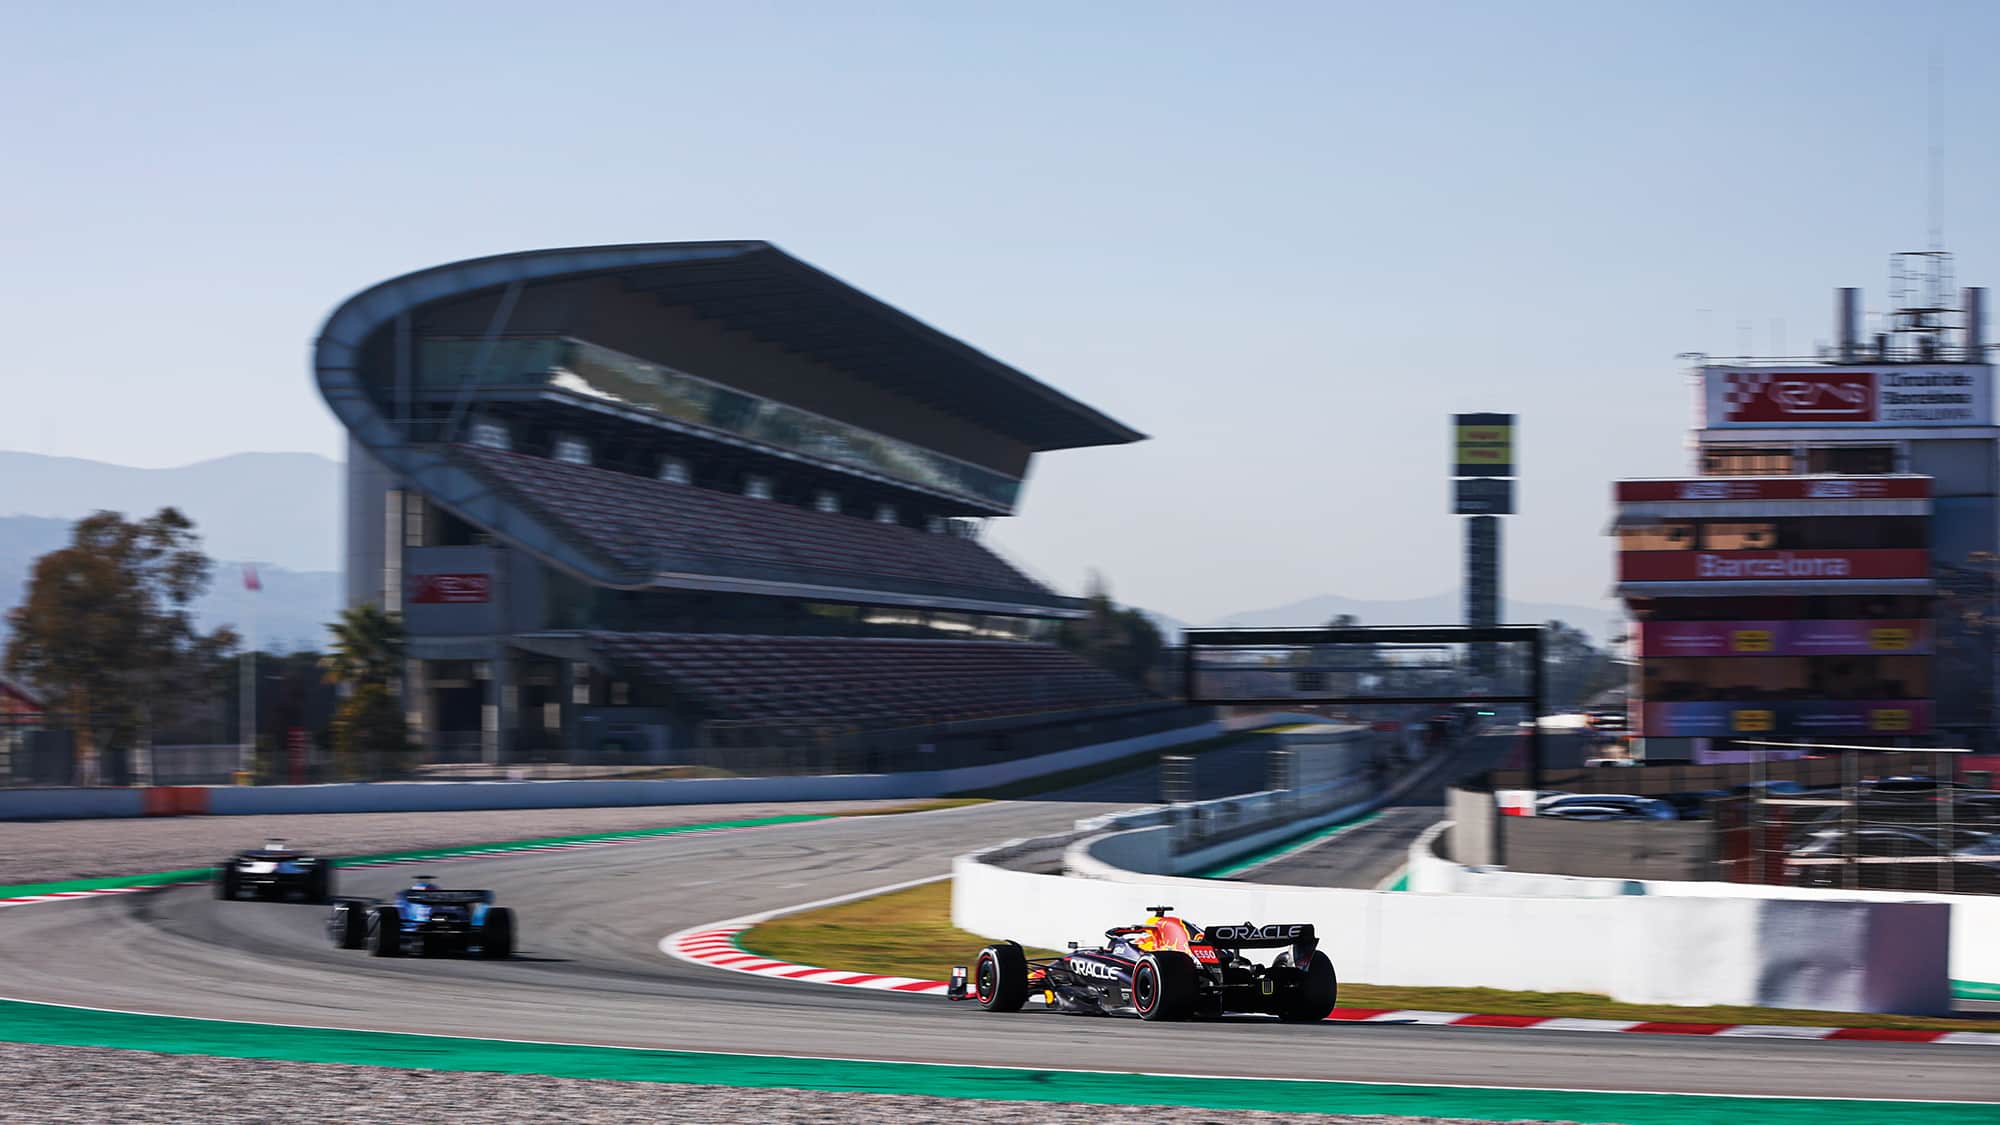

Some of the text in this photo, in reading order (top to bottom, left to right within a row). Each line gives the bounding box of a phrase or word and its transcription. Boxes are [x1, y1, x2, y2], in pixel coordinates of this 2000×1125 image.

[1696, 552, 1849, 577] Barcelona
[1215, 925, 1304, 941] ORACLE
[1193, 949, 1217, 960] ESSO
[1070, 959, 1123, 981] ORACLE
